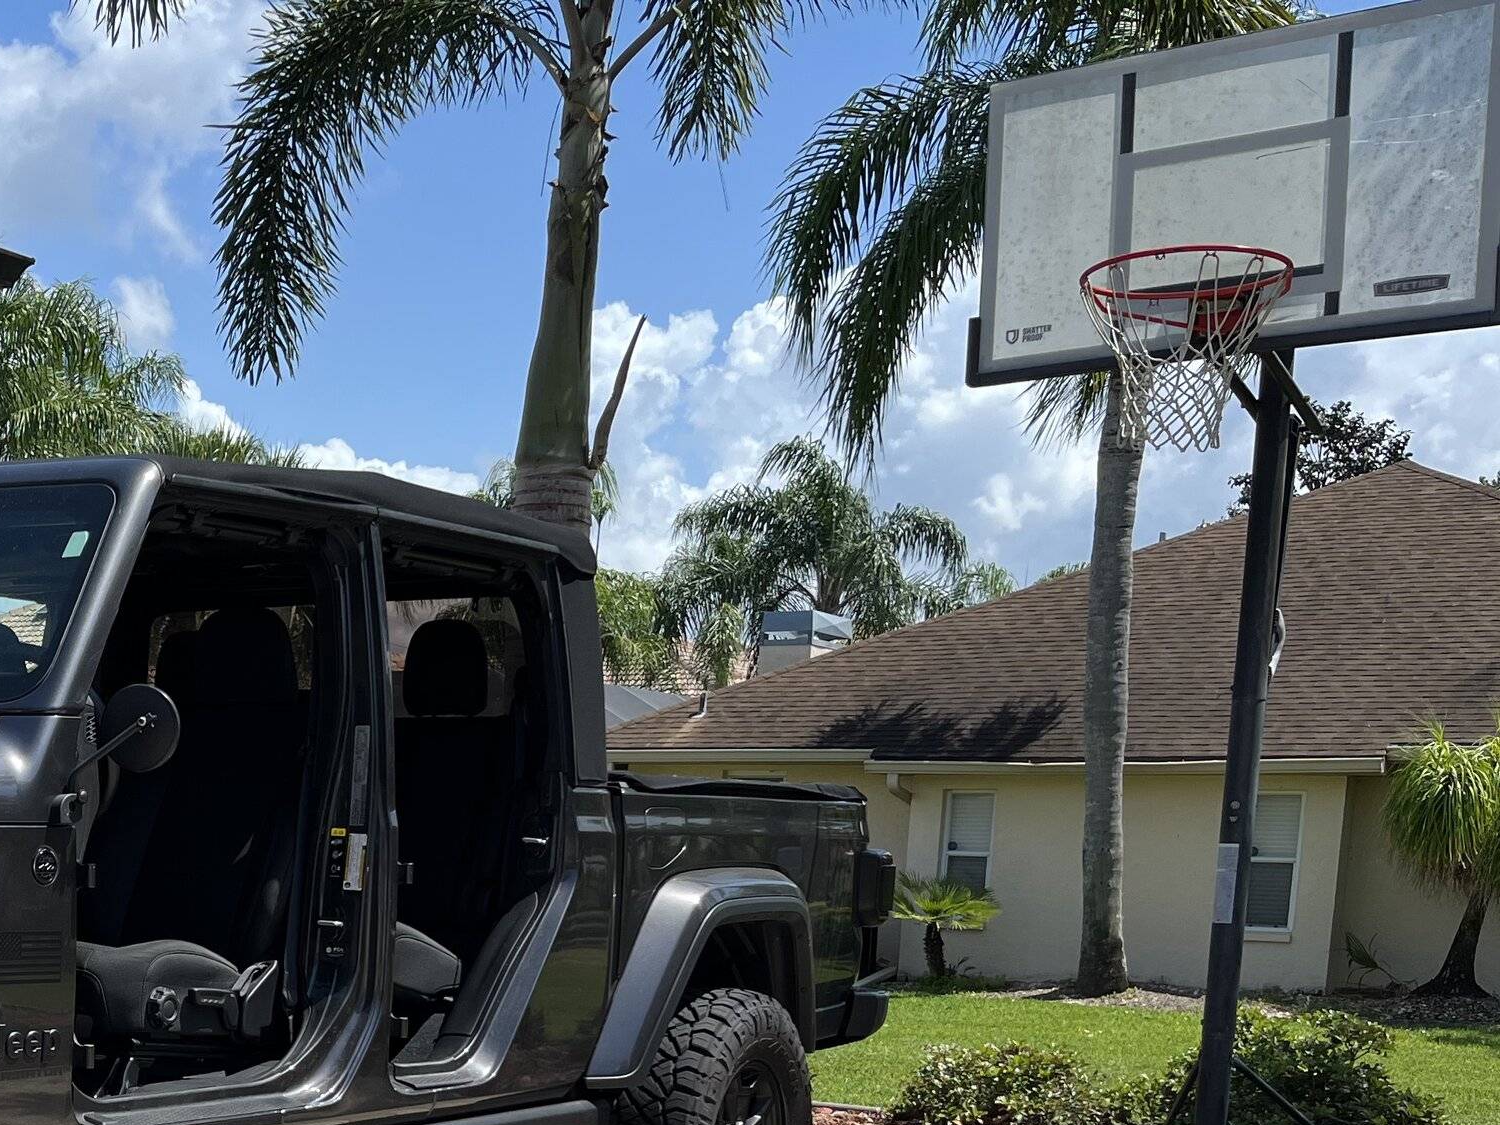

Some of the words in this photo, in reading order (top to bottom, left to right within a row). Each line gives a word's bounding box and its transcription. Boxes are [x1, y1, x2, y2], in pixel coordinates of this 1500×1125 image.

[1382, 278, 1440, 293] LIFETIME
[1022, 324, 1052, 336] SHATTER
[1022, 333, 1044, 343] PROOF
